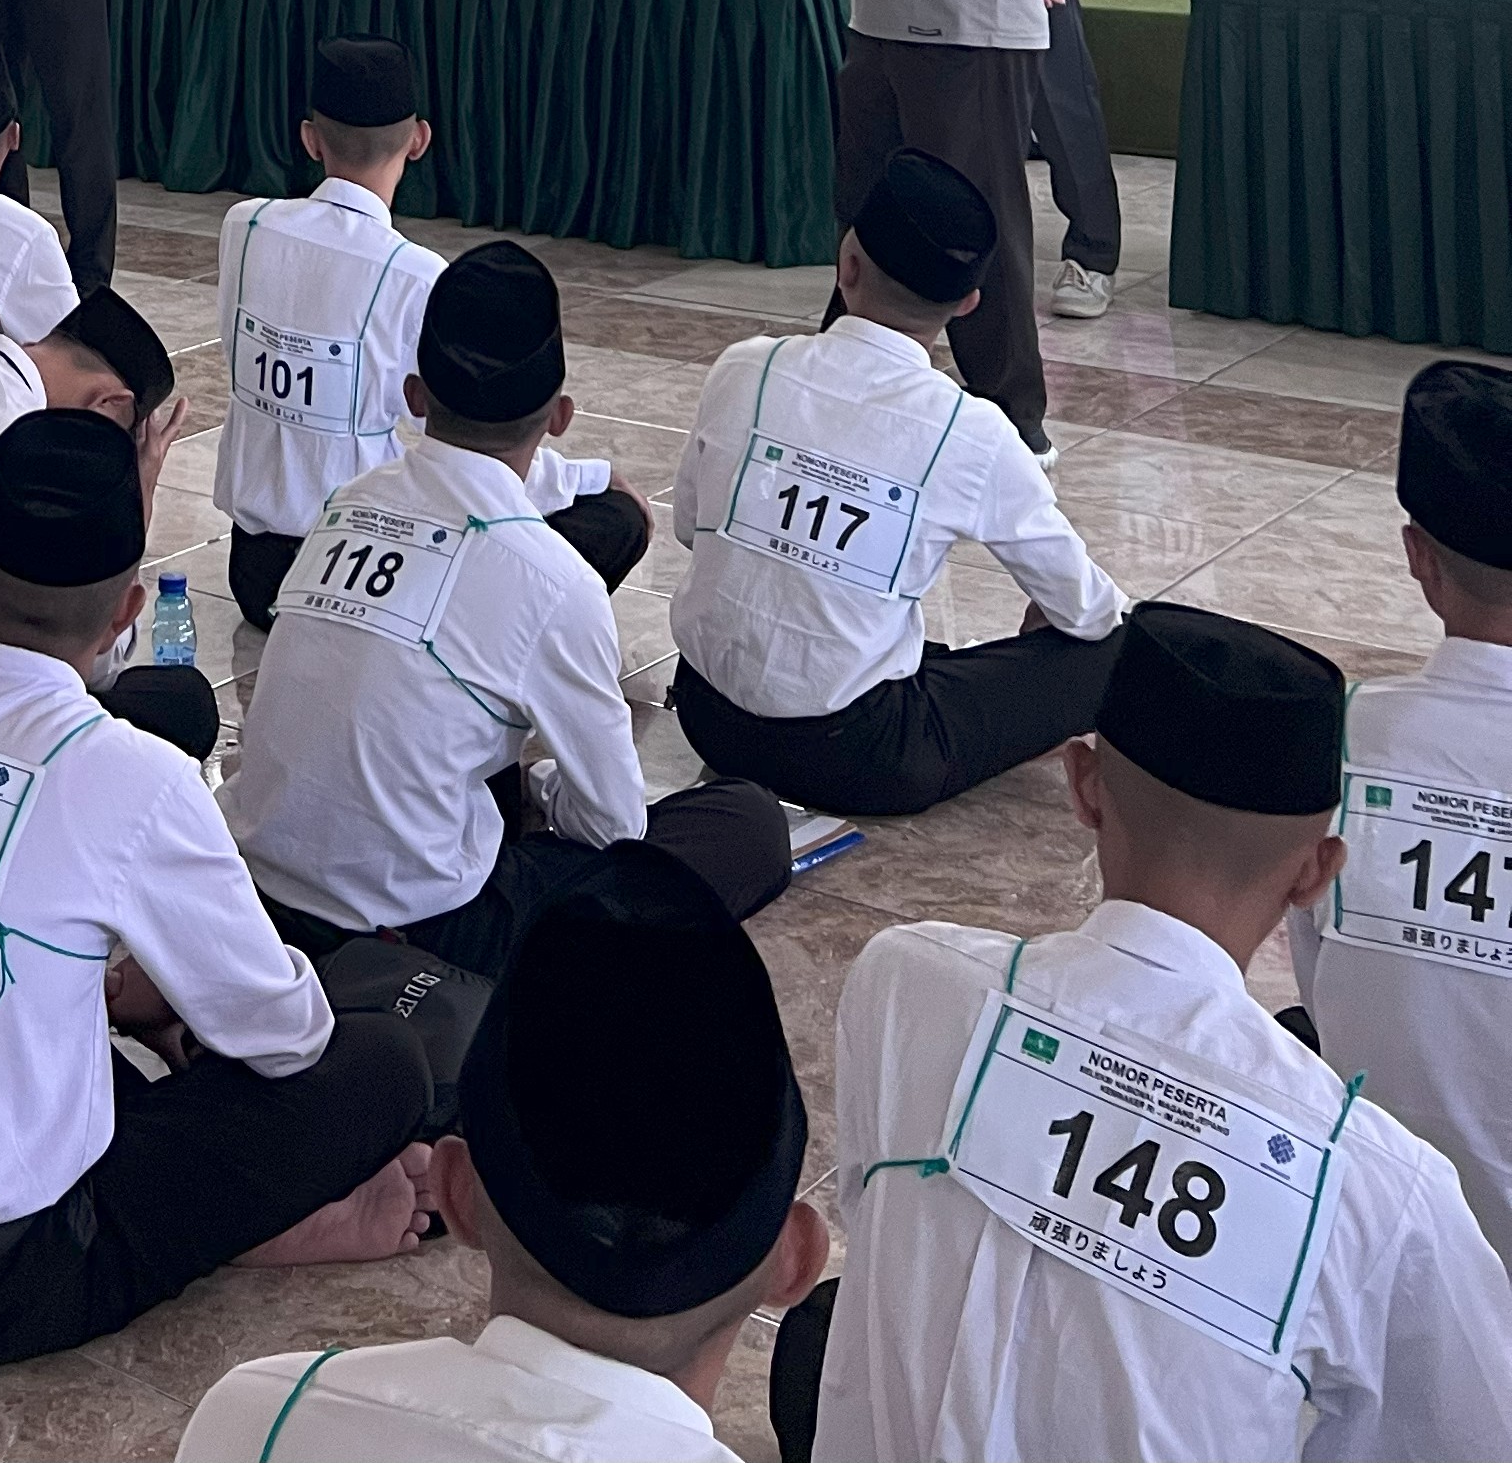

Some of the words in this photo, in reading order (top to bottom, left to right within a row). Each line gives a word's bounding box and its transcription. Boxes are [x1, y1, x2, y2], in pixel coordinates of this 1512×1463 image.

[255, 351, 313, 406] 101
[778, 484, 870, 551] 117
[320, 539, 404, 598] 118
[1418, 791, 1469, 812] NOMOR
[1472, 801, 1512, 819] PESE
[1400, 839, 1512, 928] 14
[1088, 1049, 1150, 1088] NOMOR
[1151, 1074, 1229, 1123] PESERTA
[1048, 1109, 1226, 1258] 148
[1028, 1210, 1168, 1290] 頑張りましょう
